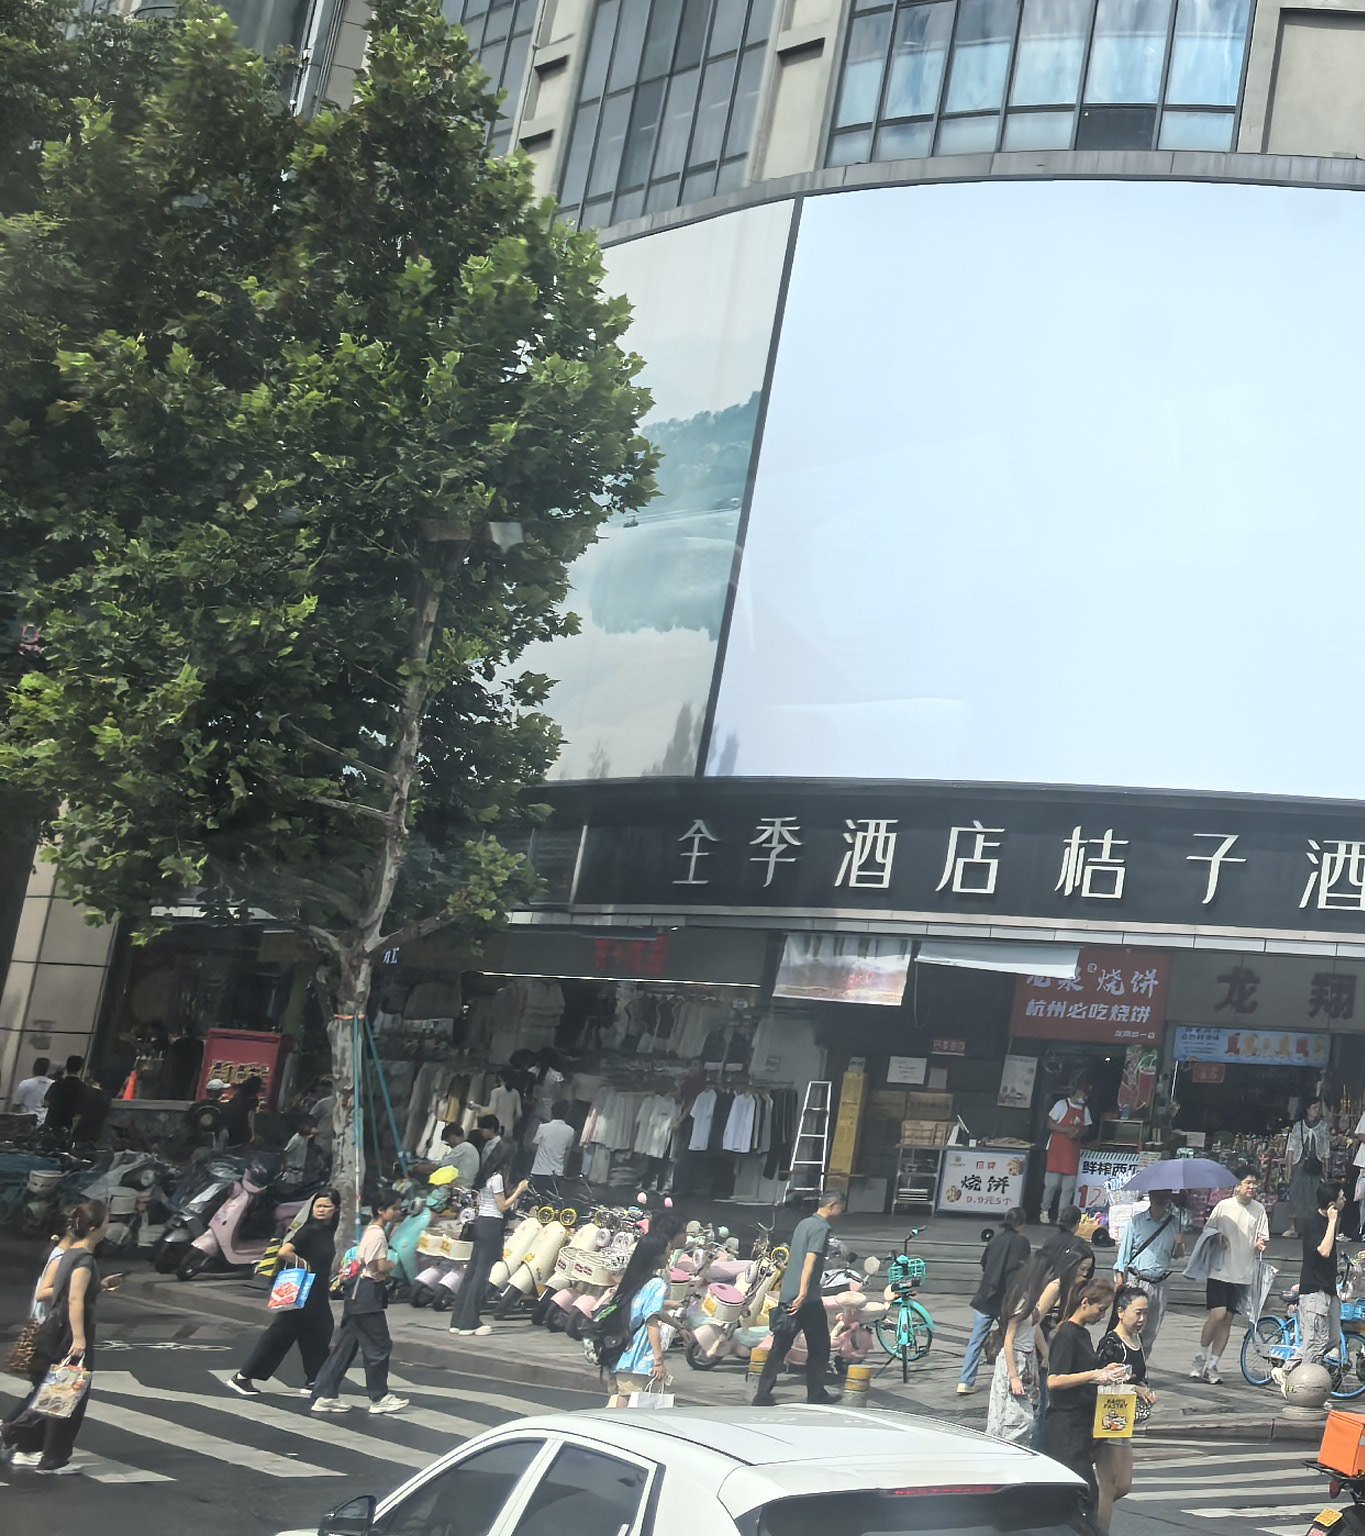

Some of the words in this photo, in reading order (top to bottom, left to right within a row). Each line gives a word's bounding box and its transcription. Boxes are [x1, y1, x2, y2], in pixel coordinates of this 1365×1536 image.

[1025, 998, 1151, 1024] 杭州必吃烧饼
[960, 1174, 1010, 1195] 烧饼
